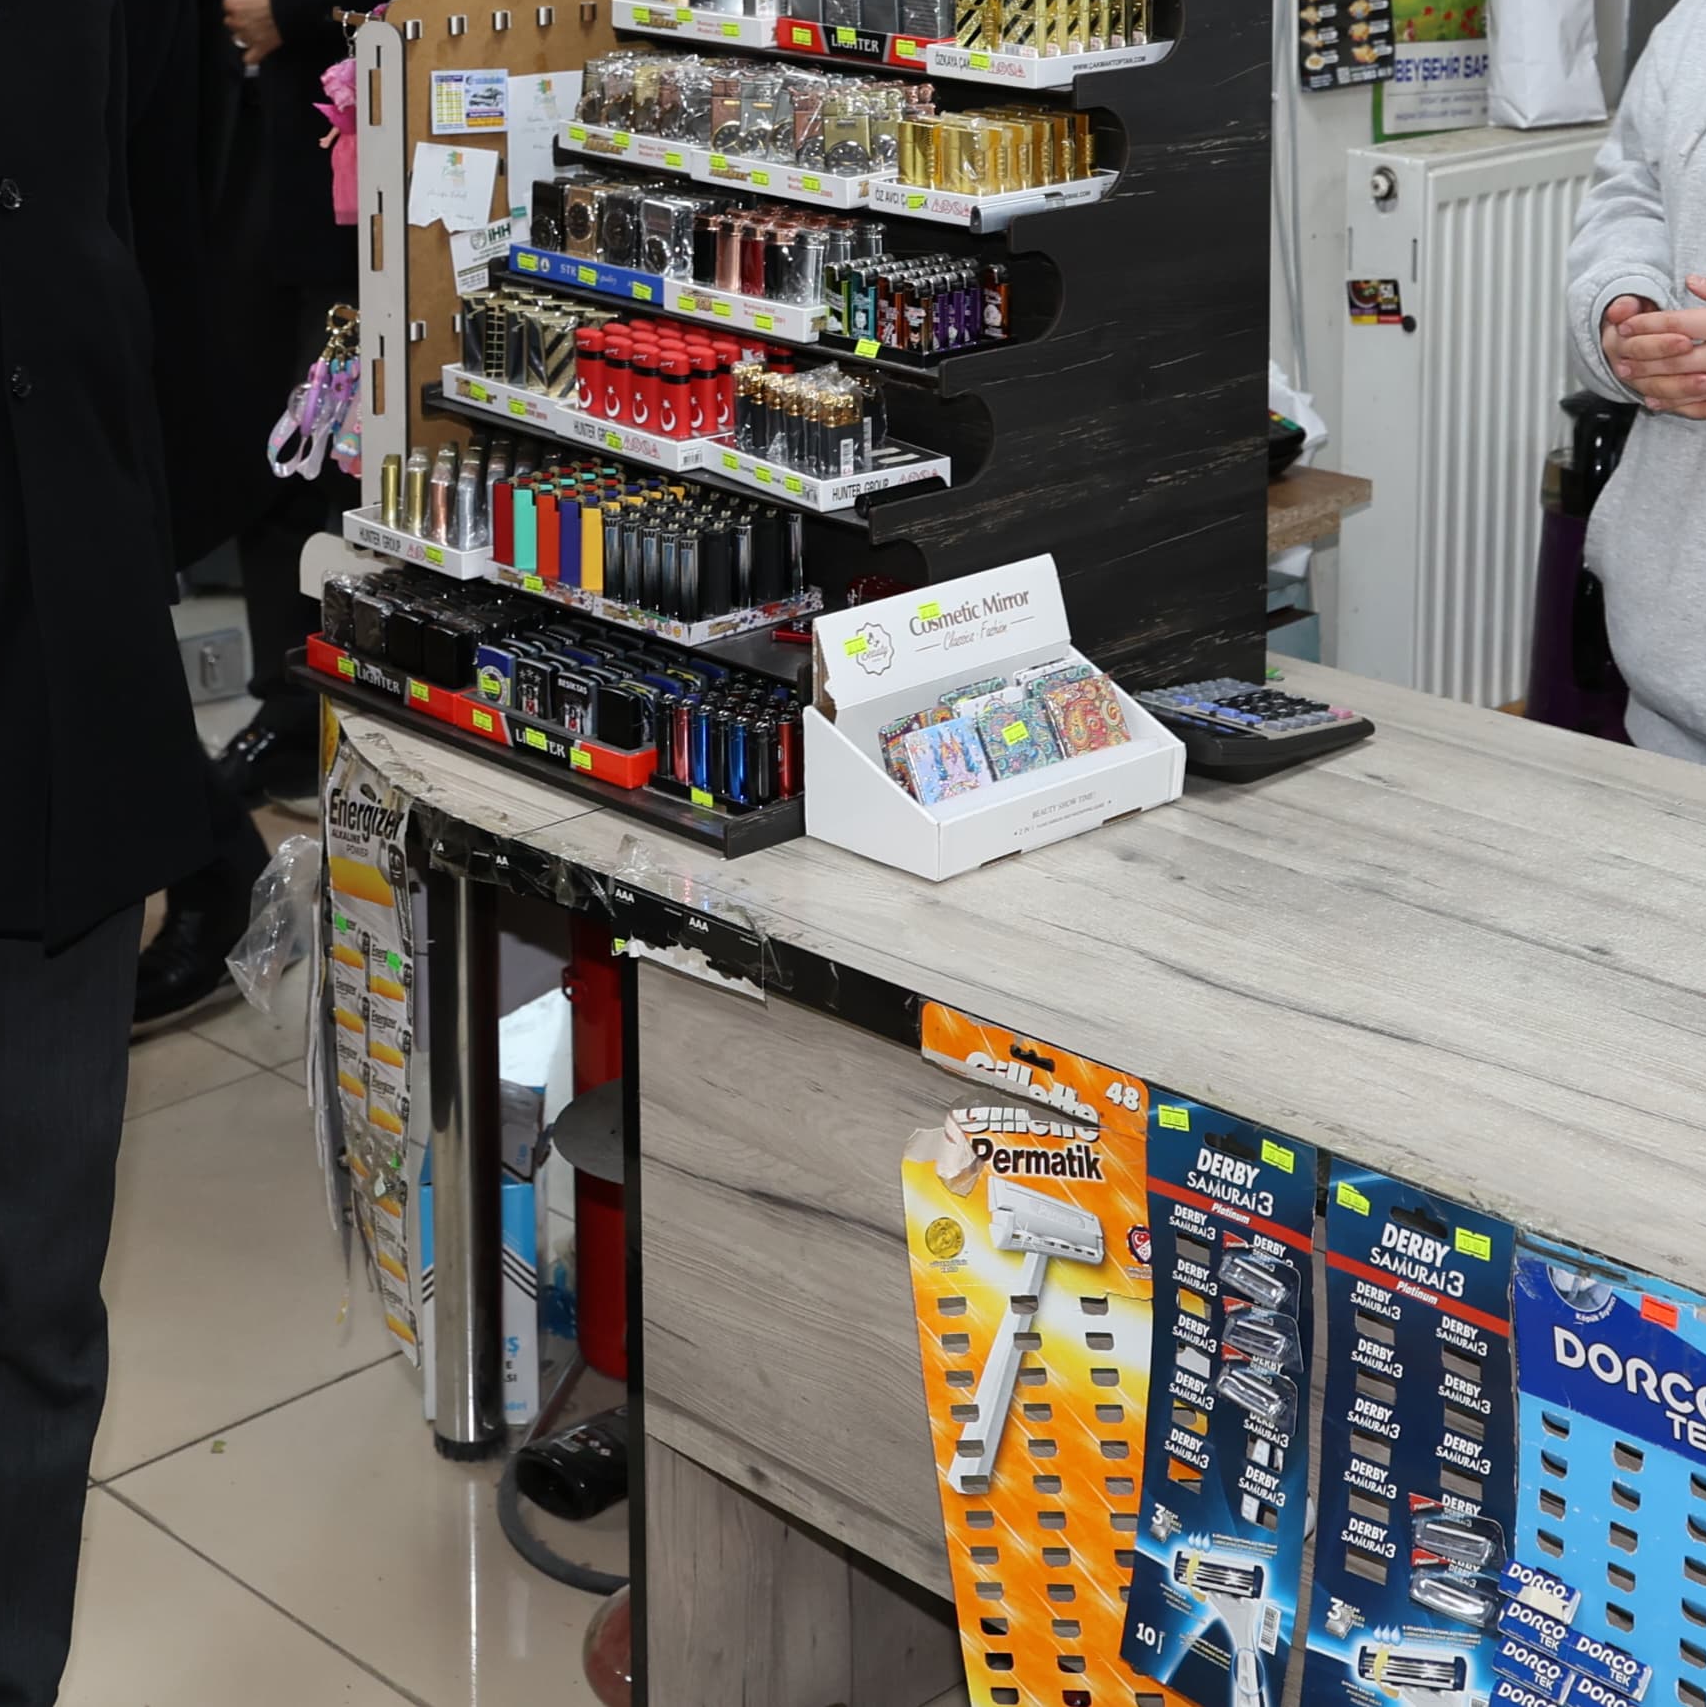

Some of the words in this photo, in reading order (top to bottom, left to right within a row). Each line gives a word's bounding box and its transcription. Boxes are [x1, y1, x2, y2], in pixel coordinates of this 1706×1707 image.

[1395, 54, 1461, 86] BEYŞEHİR
[832, 485, 862, 503] HUNTER
[359, 527, 382, 546] HUNTER
[983, 589, 1030, 616] Mirror
[515, 727, 566, 758] LITER
[329, 788, 405, 843] Energizer
[615, 887, 635, 904] AAA
[689, 915, 709, 933] AAA
[1105, 1081, 1140, 1112] 48
[971, 1138, 1104, 1181] Permatik
[1196, 1147, 1261, 1189] DERBY
[1174, 1204, 1208, 1226] DERBY
[1211, 1202, 1250, 1224] Platinum
[1381, 1222, 1451, 1268] DERBY
[1177, 1259, 1210, 1281] DERBY
[1356, 1280, 1392, 1305] DERBY
[1396, 1280, 1439, 1305] Platinum
[1178, 1314, 1211, 1338] DERBY
[1441, 1315, 1479, 1341] DERBY
[1357, 1338, 1395, 1363] DERBY
[1175, 1371, 1208, 1395] DERBY
[1444, 1373, 1481, 1398] DERBY
[1355, 1397, 1393, 1423] DERBY
[1171, 1428, 1204, 1452] DERBY
[1444, 1432, 1483, 1458] DERBY
[1245, 1465, 1280, 1490] DERBY
[1350, 1458, 1389, 1483] DERBY
[1348, 1518, 1388, 1543] DERBY
[1508, 1563, 1566, 1601] DORCO
[1507, 1602, 1566, 1640] DORCO
[1135, 1623, 1156, 1646] 10
[1539, 1632, 1560, 1652] TEK
[1502, 1641, 1561, 1678] DORCO
[1576, 1636, 1637, 1675] DORCO
[1533, 1671, 1555, 1691] TEK
[1609, 1668, 1631, 1687] TEK
